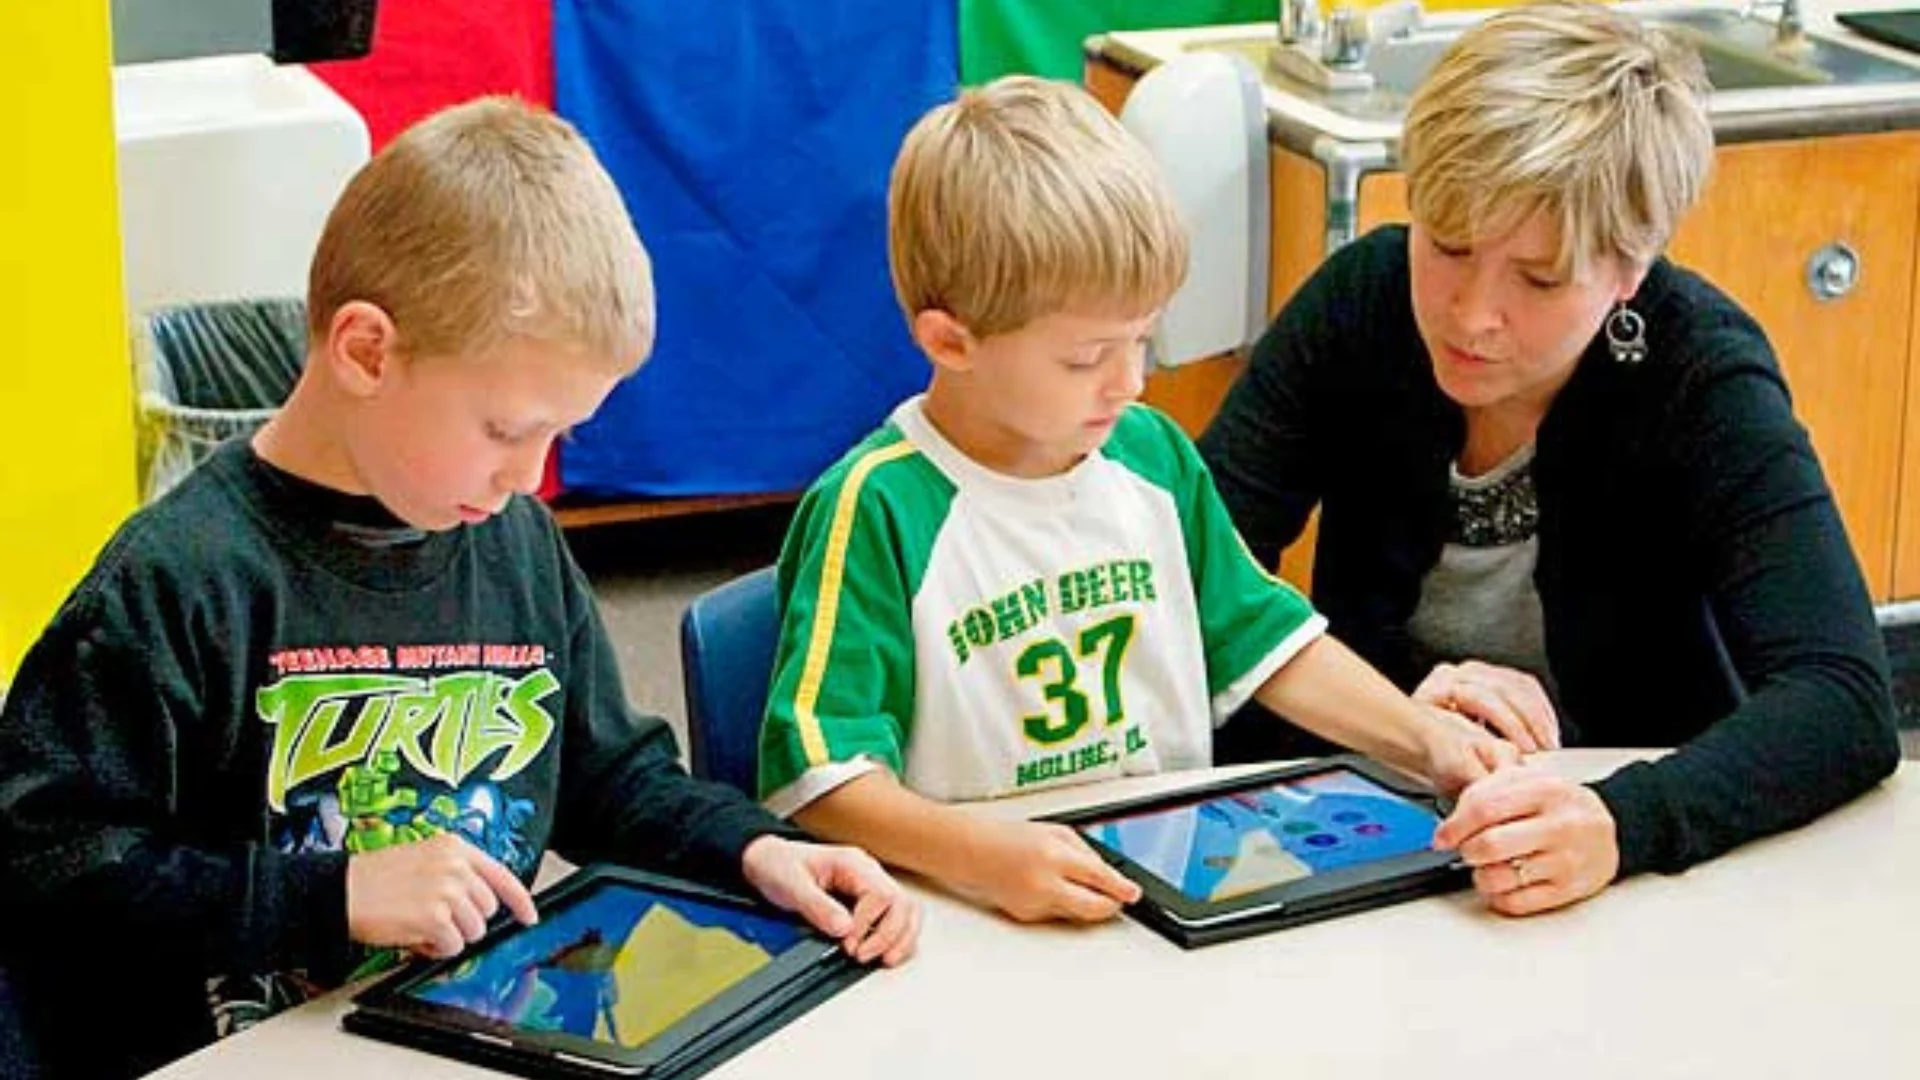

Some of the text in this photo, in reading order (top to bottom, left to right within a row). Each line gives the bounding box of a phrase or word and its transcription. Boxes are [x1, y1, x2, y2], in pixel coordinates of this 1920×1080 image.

[947, 558, 1157, 665] JOHN DEER
[1014, 611, 1138, 746] 37
[256, 668, 561, 814] TURTLES
